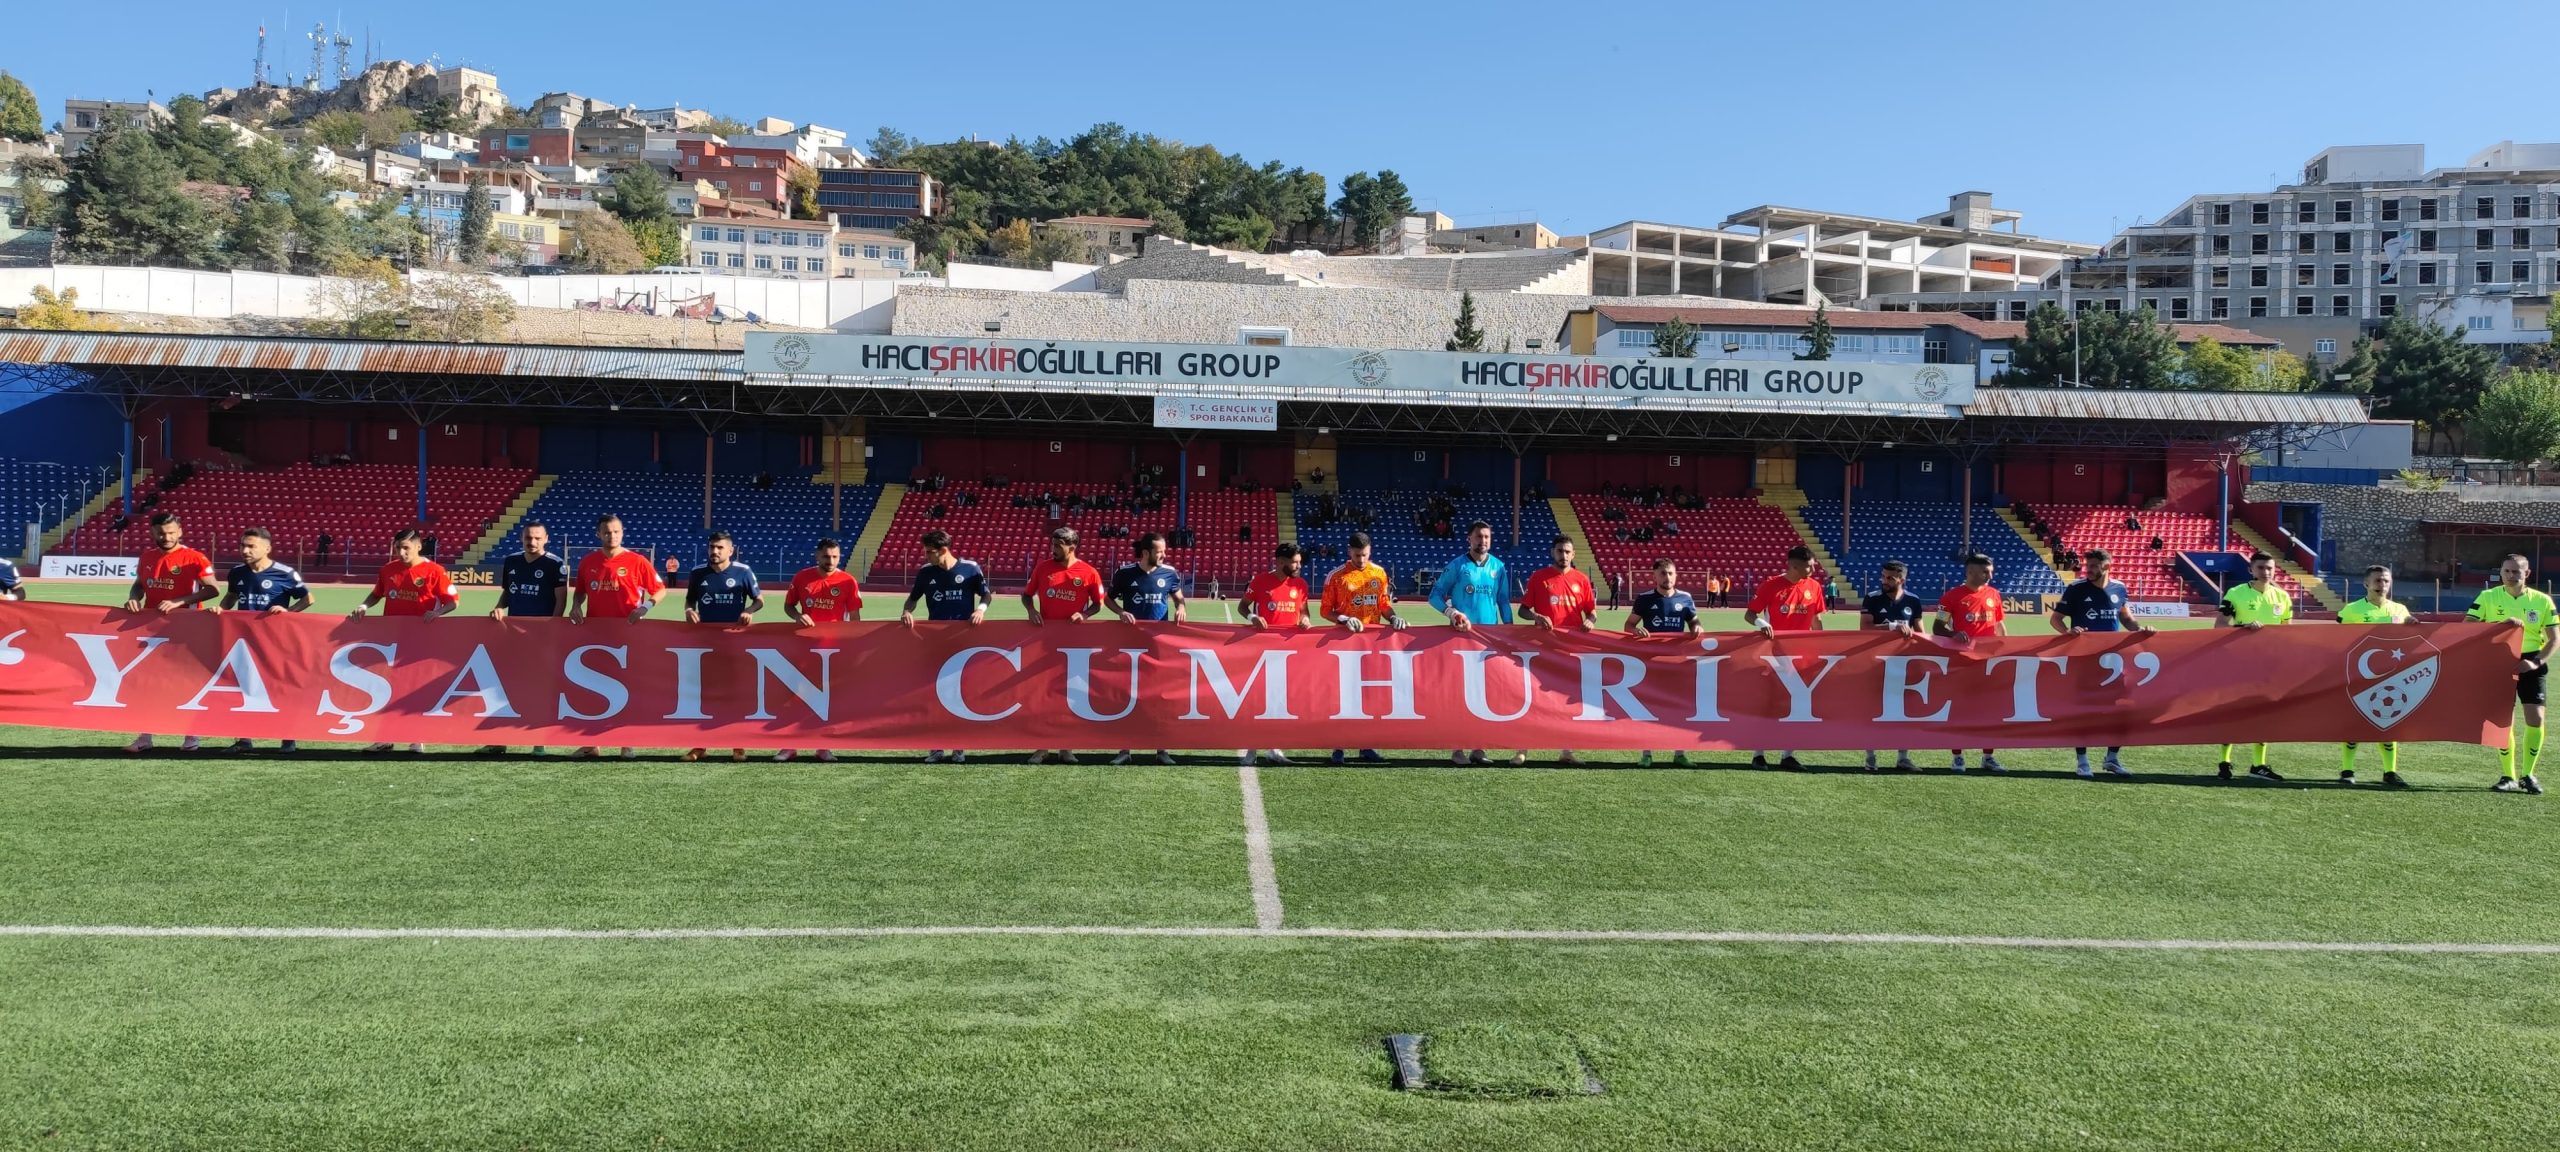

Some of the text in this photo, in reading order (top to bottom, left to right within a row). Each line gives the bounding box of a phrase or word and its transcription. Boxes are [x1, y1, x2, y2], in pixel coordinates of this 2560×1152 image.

[862, 341, 1281, 378] HACIŞAKİROĞULLARI GROUP
[1462, 358, 1863, 394] HACIŞAKİROĞULLARI GROUP
[1190, 404, 1274, 415] T.C. GENÇLİK VE
[1190, 413, 1274, 424] SPOR BAKANLIĞI
[2002, 596, 2034, 612] SİNE
[2129, 604, 2151, 615] SİNE
[2402, 667, 2431, 685] 1923
